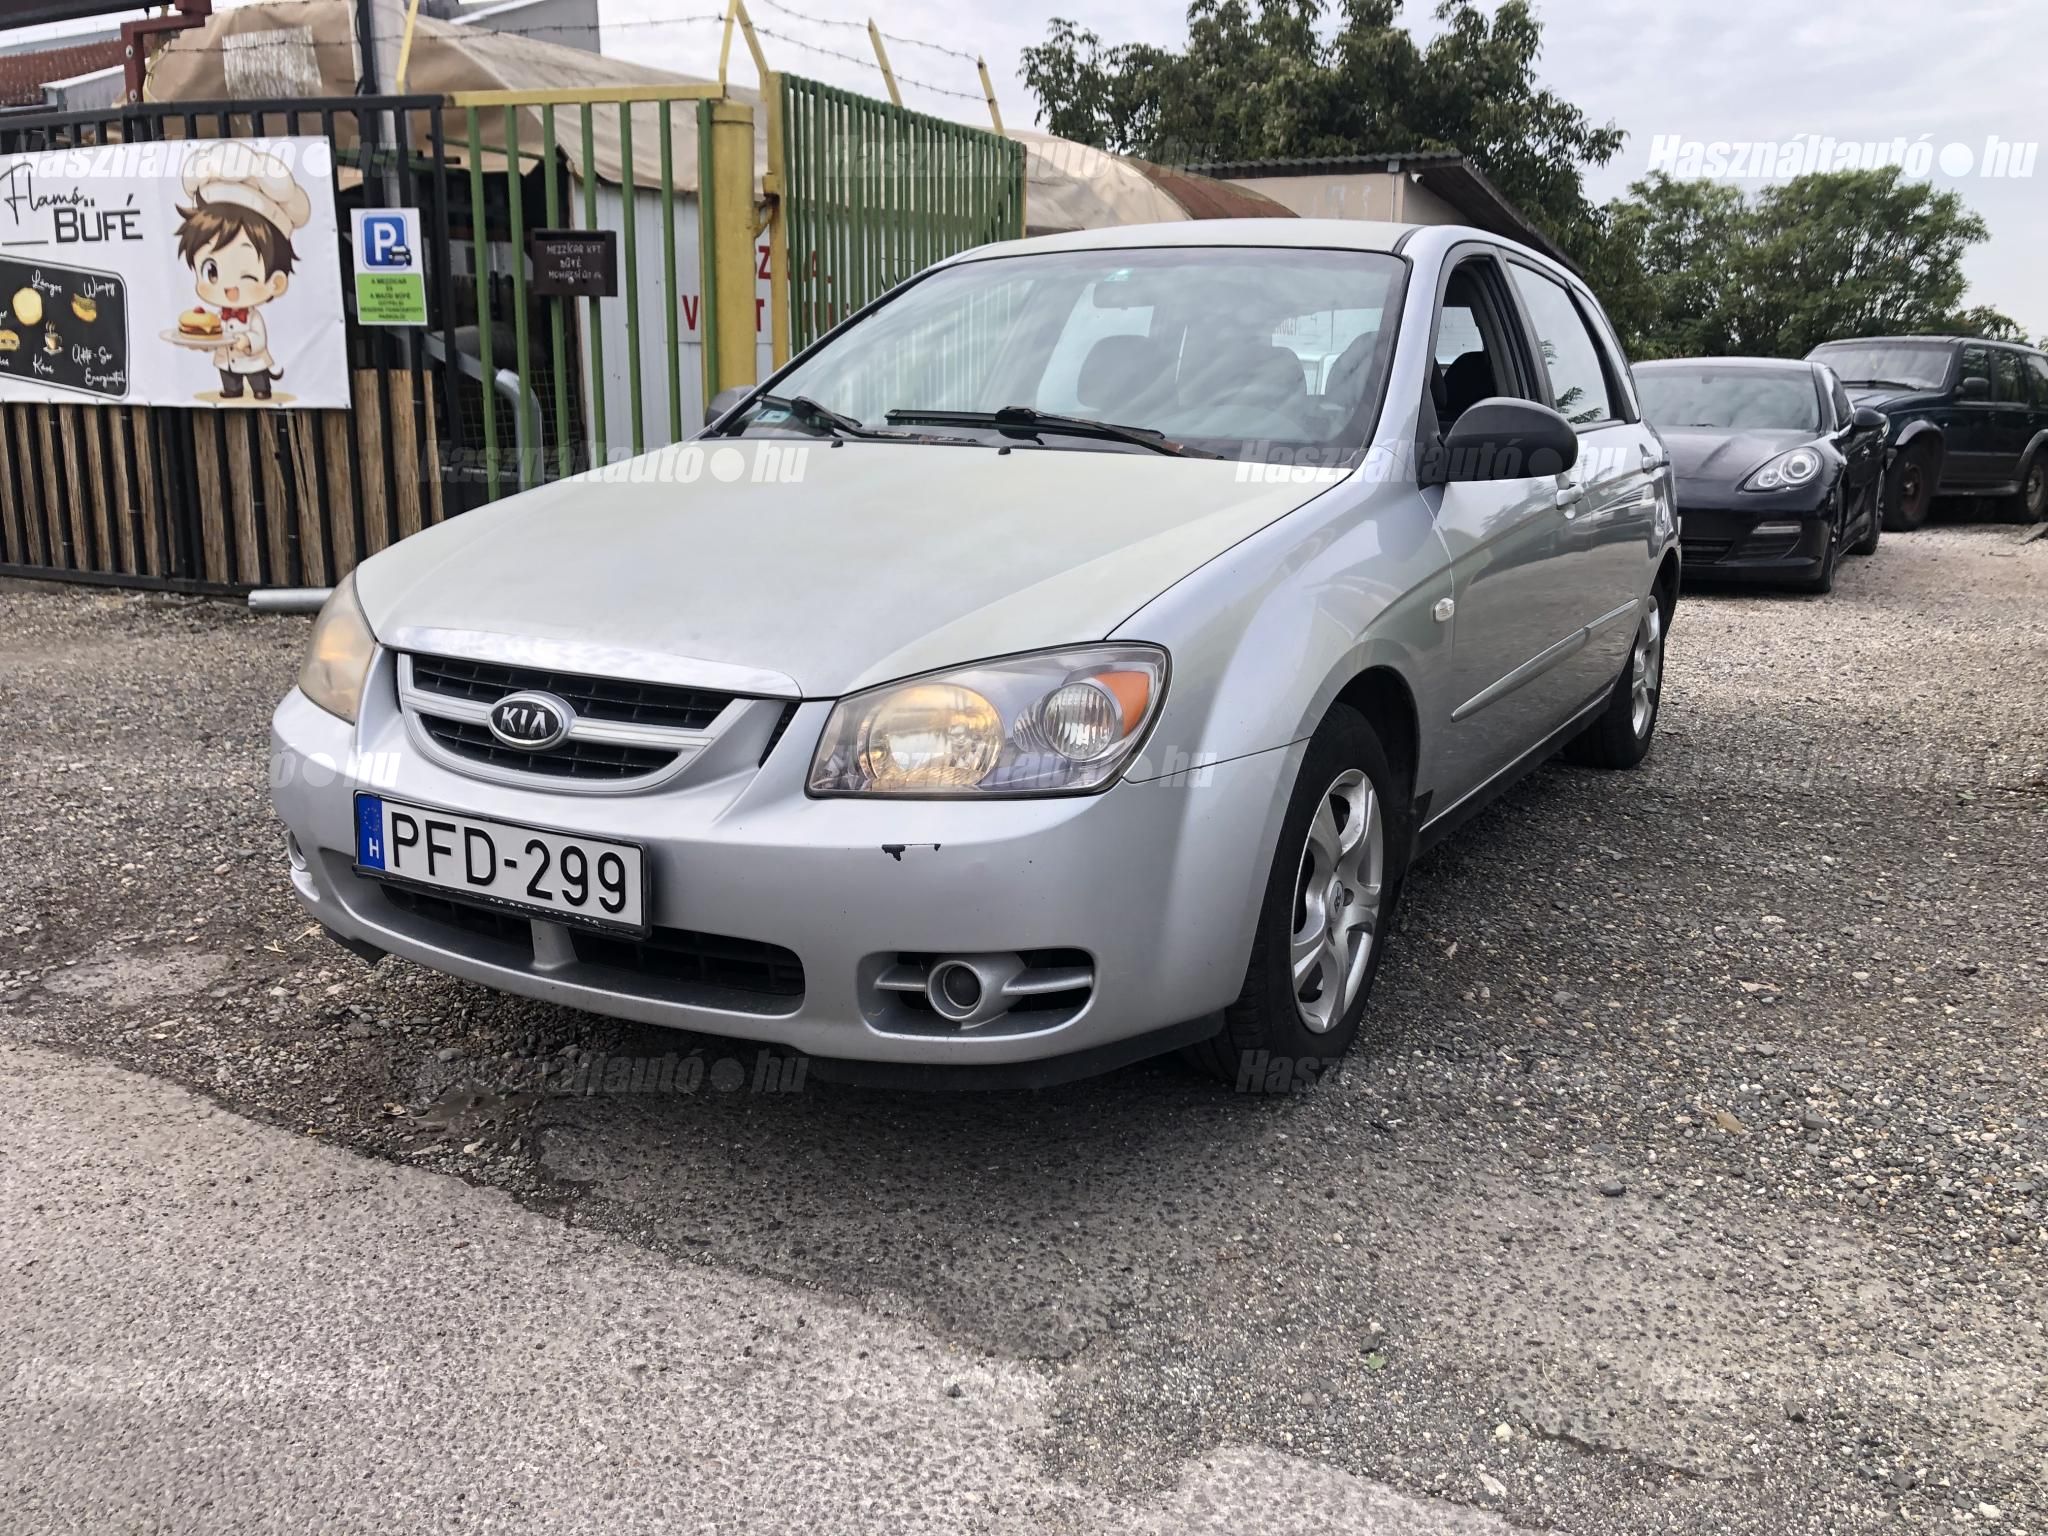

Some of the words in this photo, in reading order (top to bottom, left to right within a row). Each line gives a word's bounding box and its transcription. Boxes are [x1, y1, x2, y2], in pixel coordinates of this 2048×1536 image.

[53, 193, 144, 244] BÜFÉ
[500, 706, 548, 738] KIA
[368, 836, 380, 860] H
[391, 811, 627, 914] PFD-299
